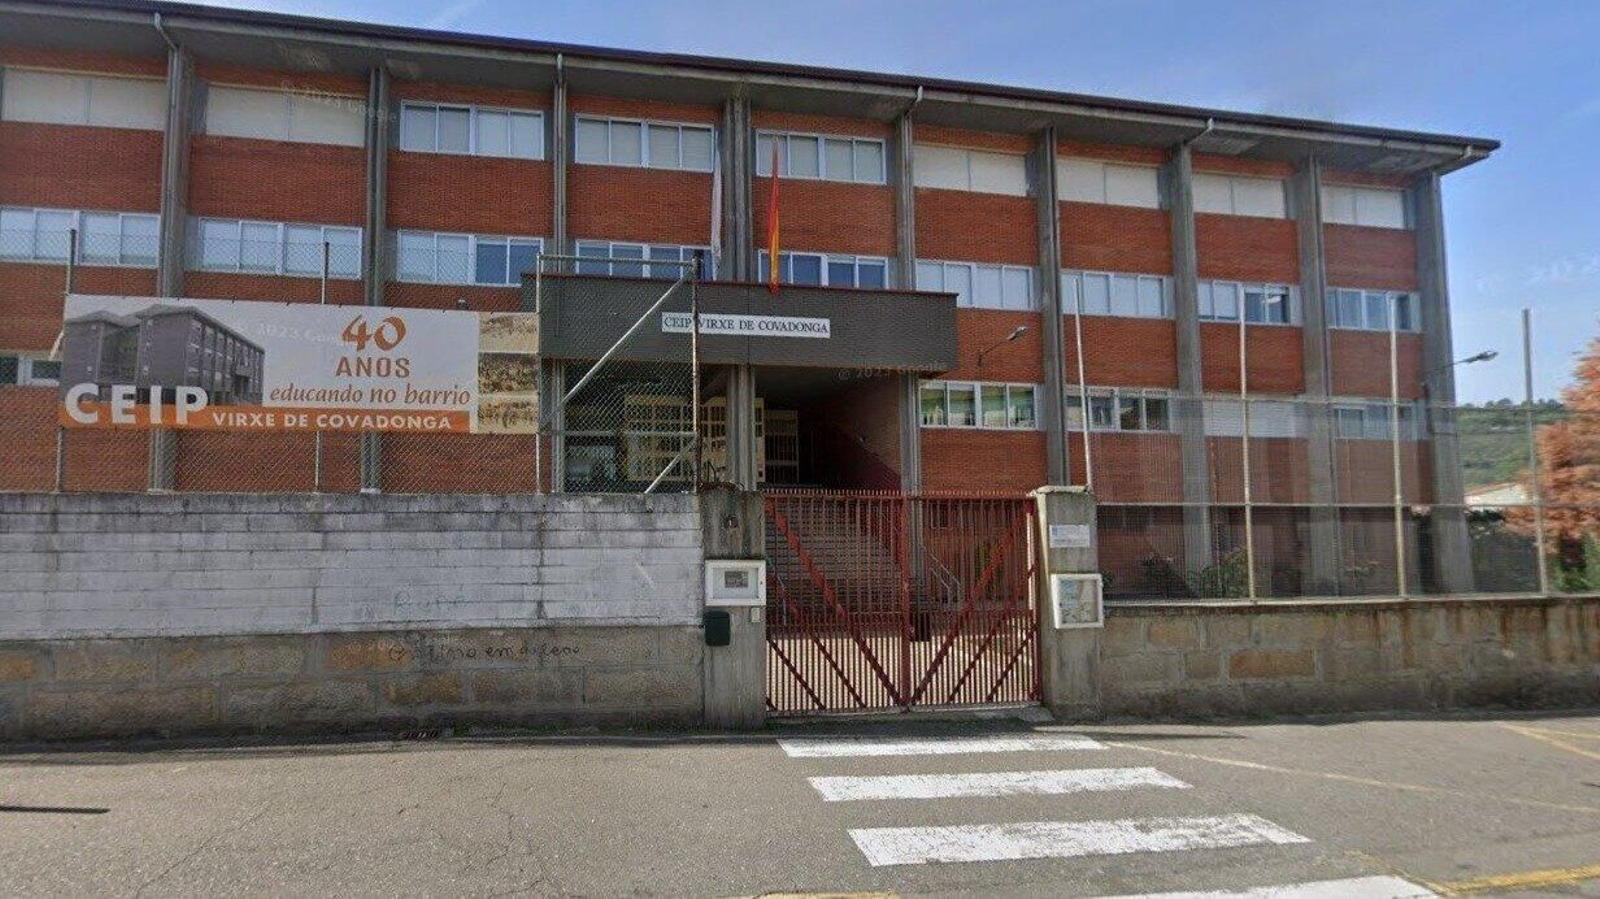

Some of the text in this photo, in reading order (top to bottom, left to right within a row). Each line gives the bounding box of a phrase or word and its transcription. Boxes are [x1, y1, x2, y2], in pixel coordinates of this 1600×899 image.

[342, 314, 407, 351] 40
[664, 316, 829, 333] CEIP VIRXE DE COVADONGA
[336, 356, 410, 378] ANOS
[65, 383, 209, 424] CEIP
[270, 383, 471, 405] educando no barrio
[212, 412, 452, 429] VIRXE DE COVADONGA
